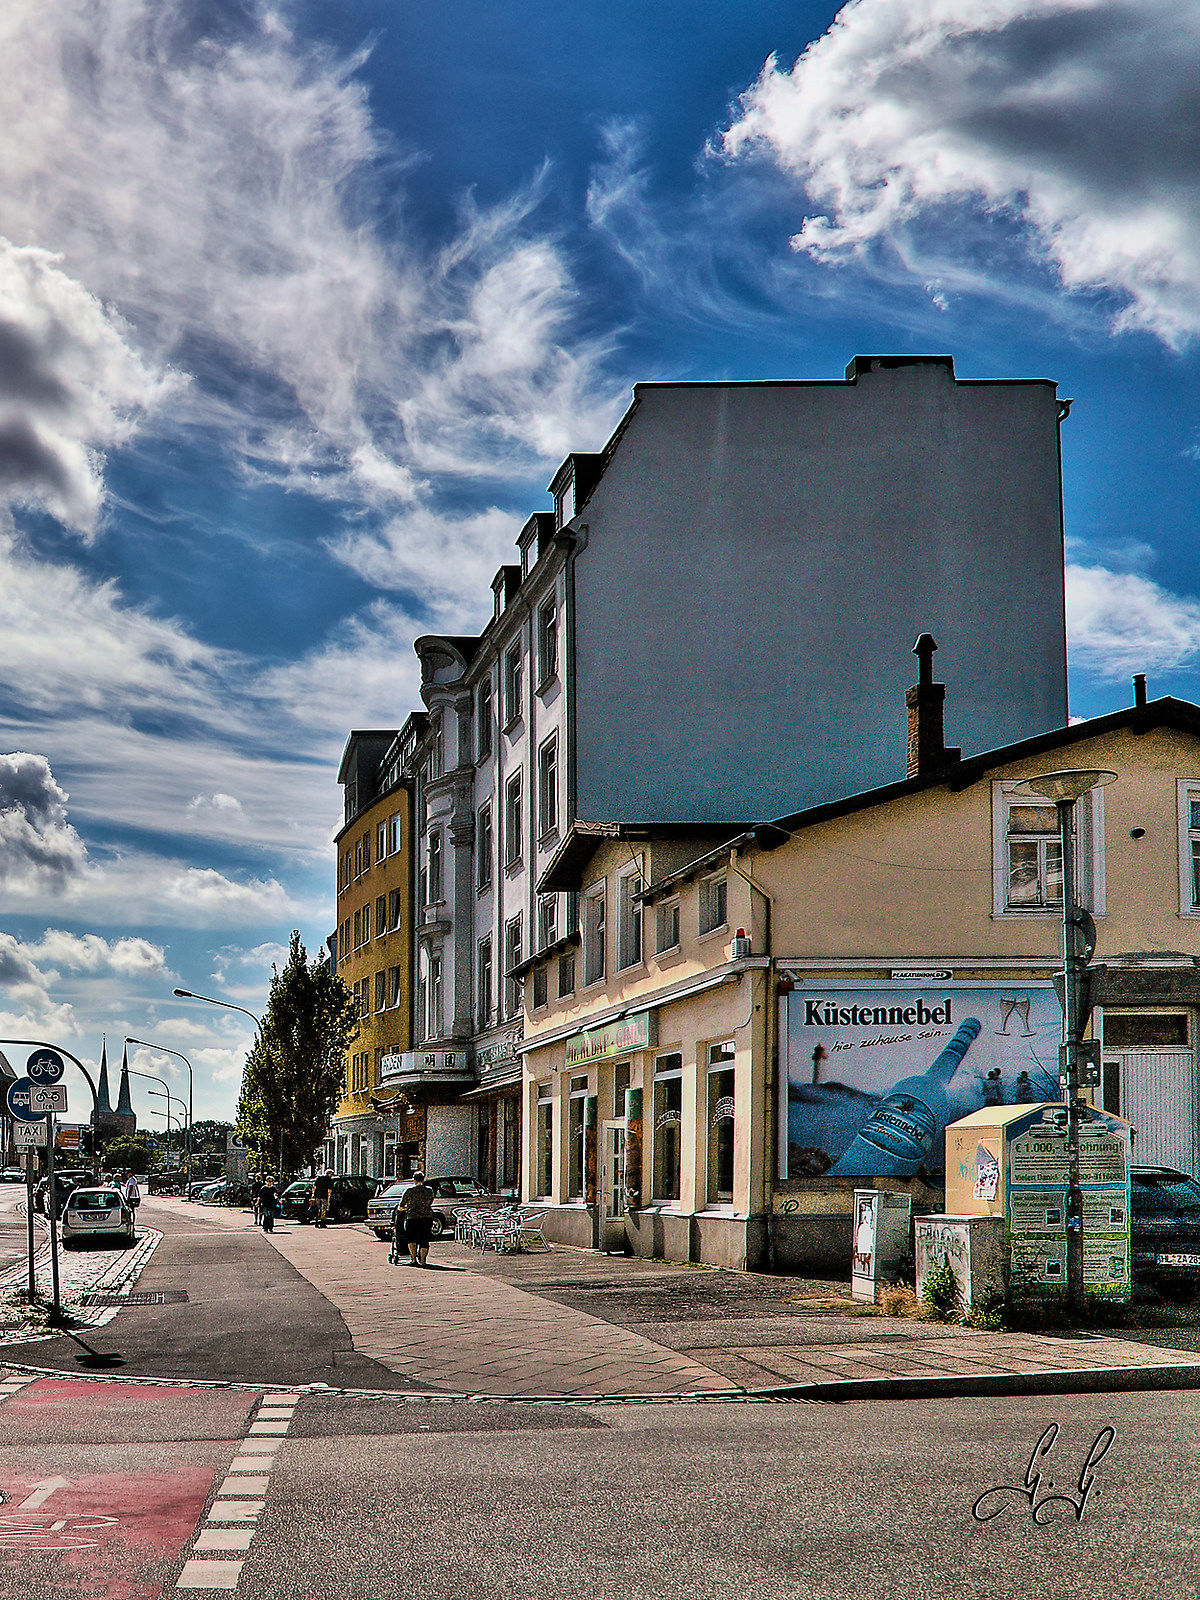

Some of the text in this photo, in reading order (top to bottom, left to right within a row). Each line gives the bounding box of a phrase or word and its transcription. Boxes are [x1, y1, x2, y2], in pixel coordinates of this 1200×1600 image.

[803, 998, 953, 1026] Küstennebel
[616, 1021, 647, 1048] GRILL
[830, 1040, 856, 1052] hier
[859, 1033, 913, 1049] zuhause
[17, 1125, 42, 1136] TAXI
[1024, 1142, 1061, 1154] 1.000,-
[1063, 1141, 1122, 1154] Bohnung!
[1161, 1254, 1172, 1263] HL
